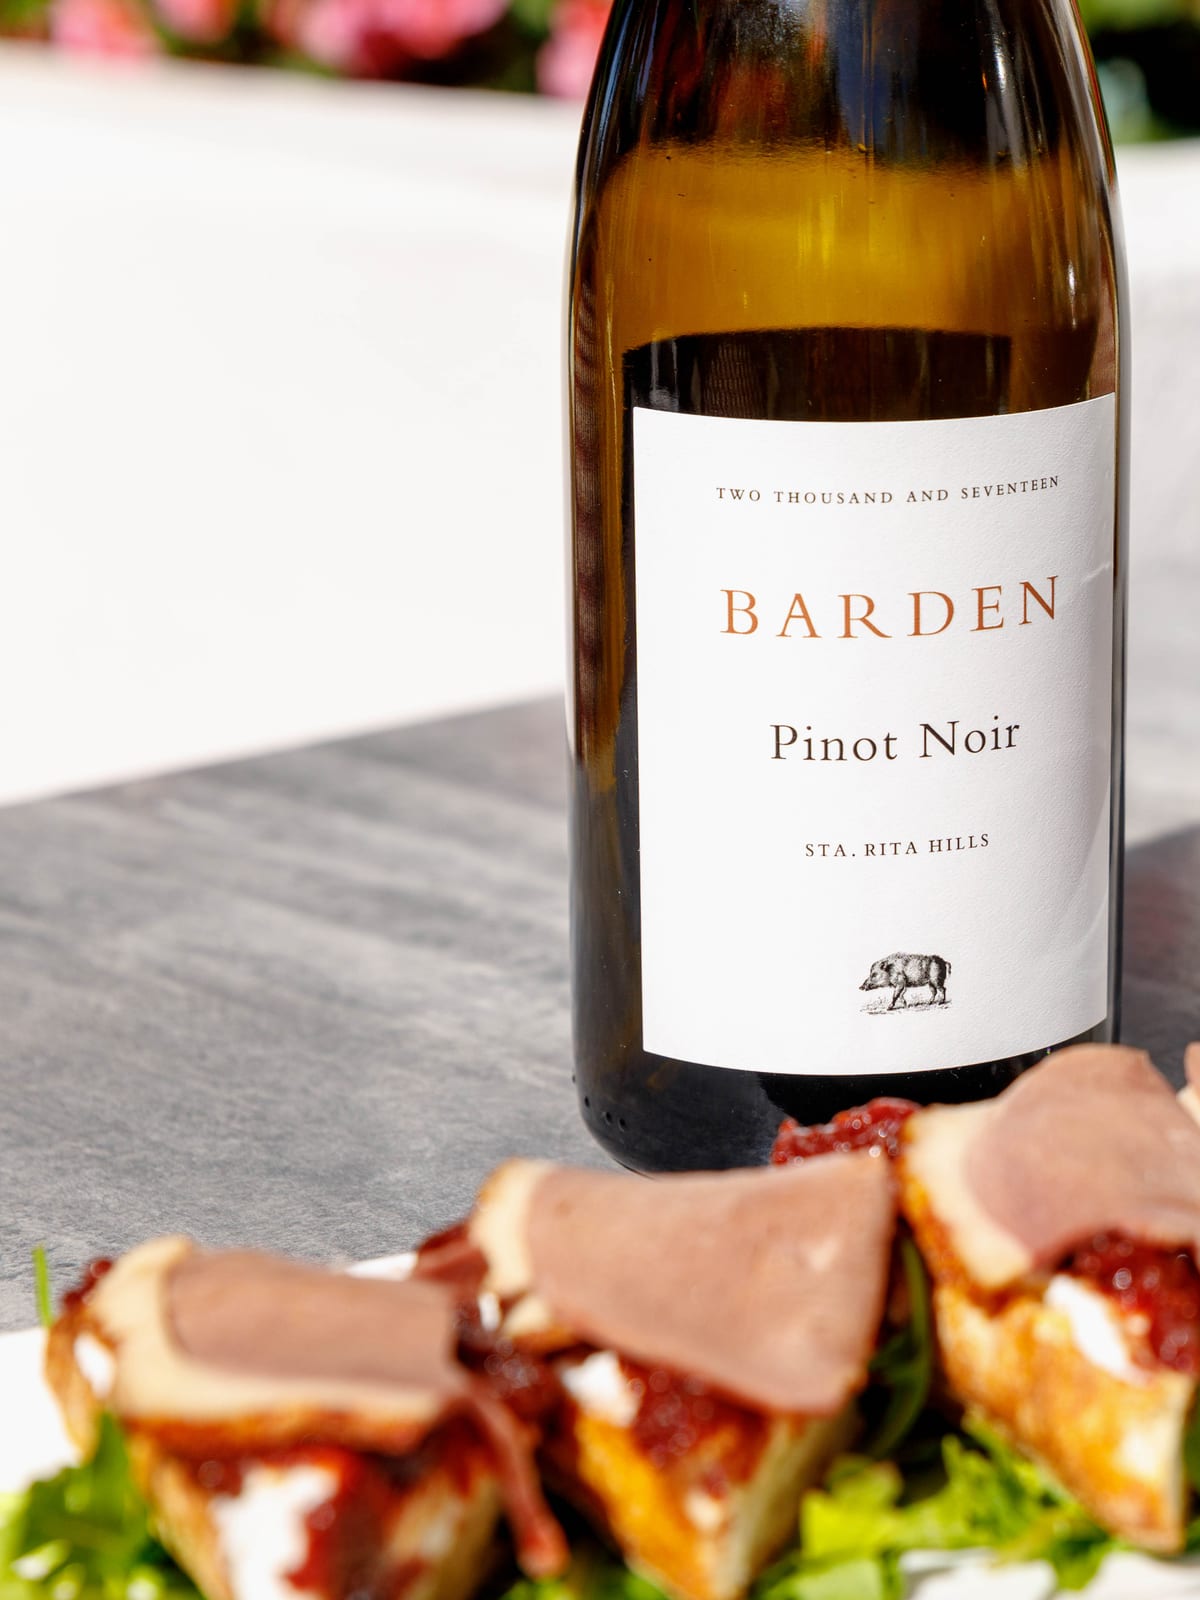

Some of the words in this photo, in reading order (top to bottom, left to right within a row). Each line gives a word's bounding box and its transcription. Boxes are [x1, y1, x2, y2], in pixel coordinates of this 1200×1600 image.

[716, 486, 761, 502] TWO
[773, 490, 893, 504] THOUSAND
[906, 489, 949, 503] AND
[961, 475, 1060, 500] SEVENTEEN
[719, 575, 1059, 639] BARDEN
[769, 724, 898, 762] Pinot
[919, 715, 1020, 759] Noir
[864, 841, 918, 857] RITA
[928, 833, 990, 854] HILLS
